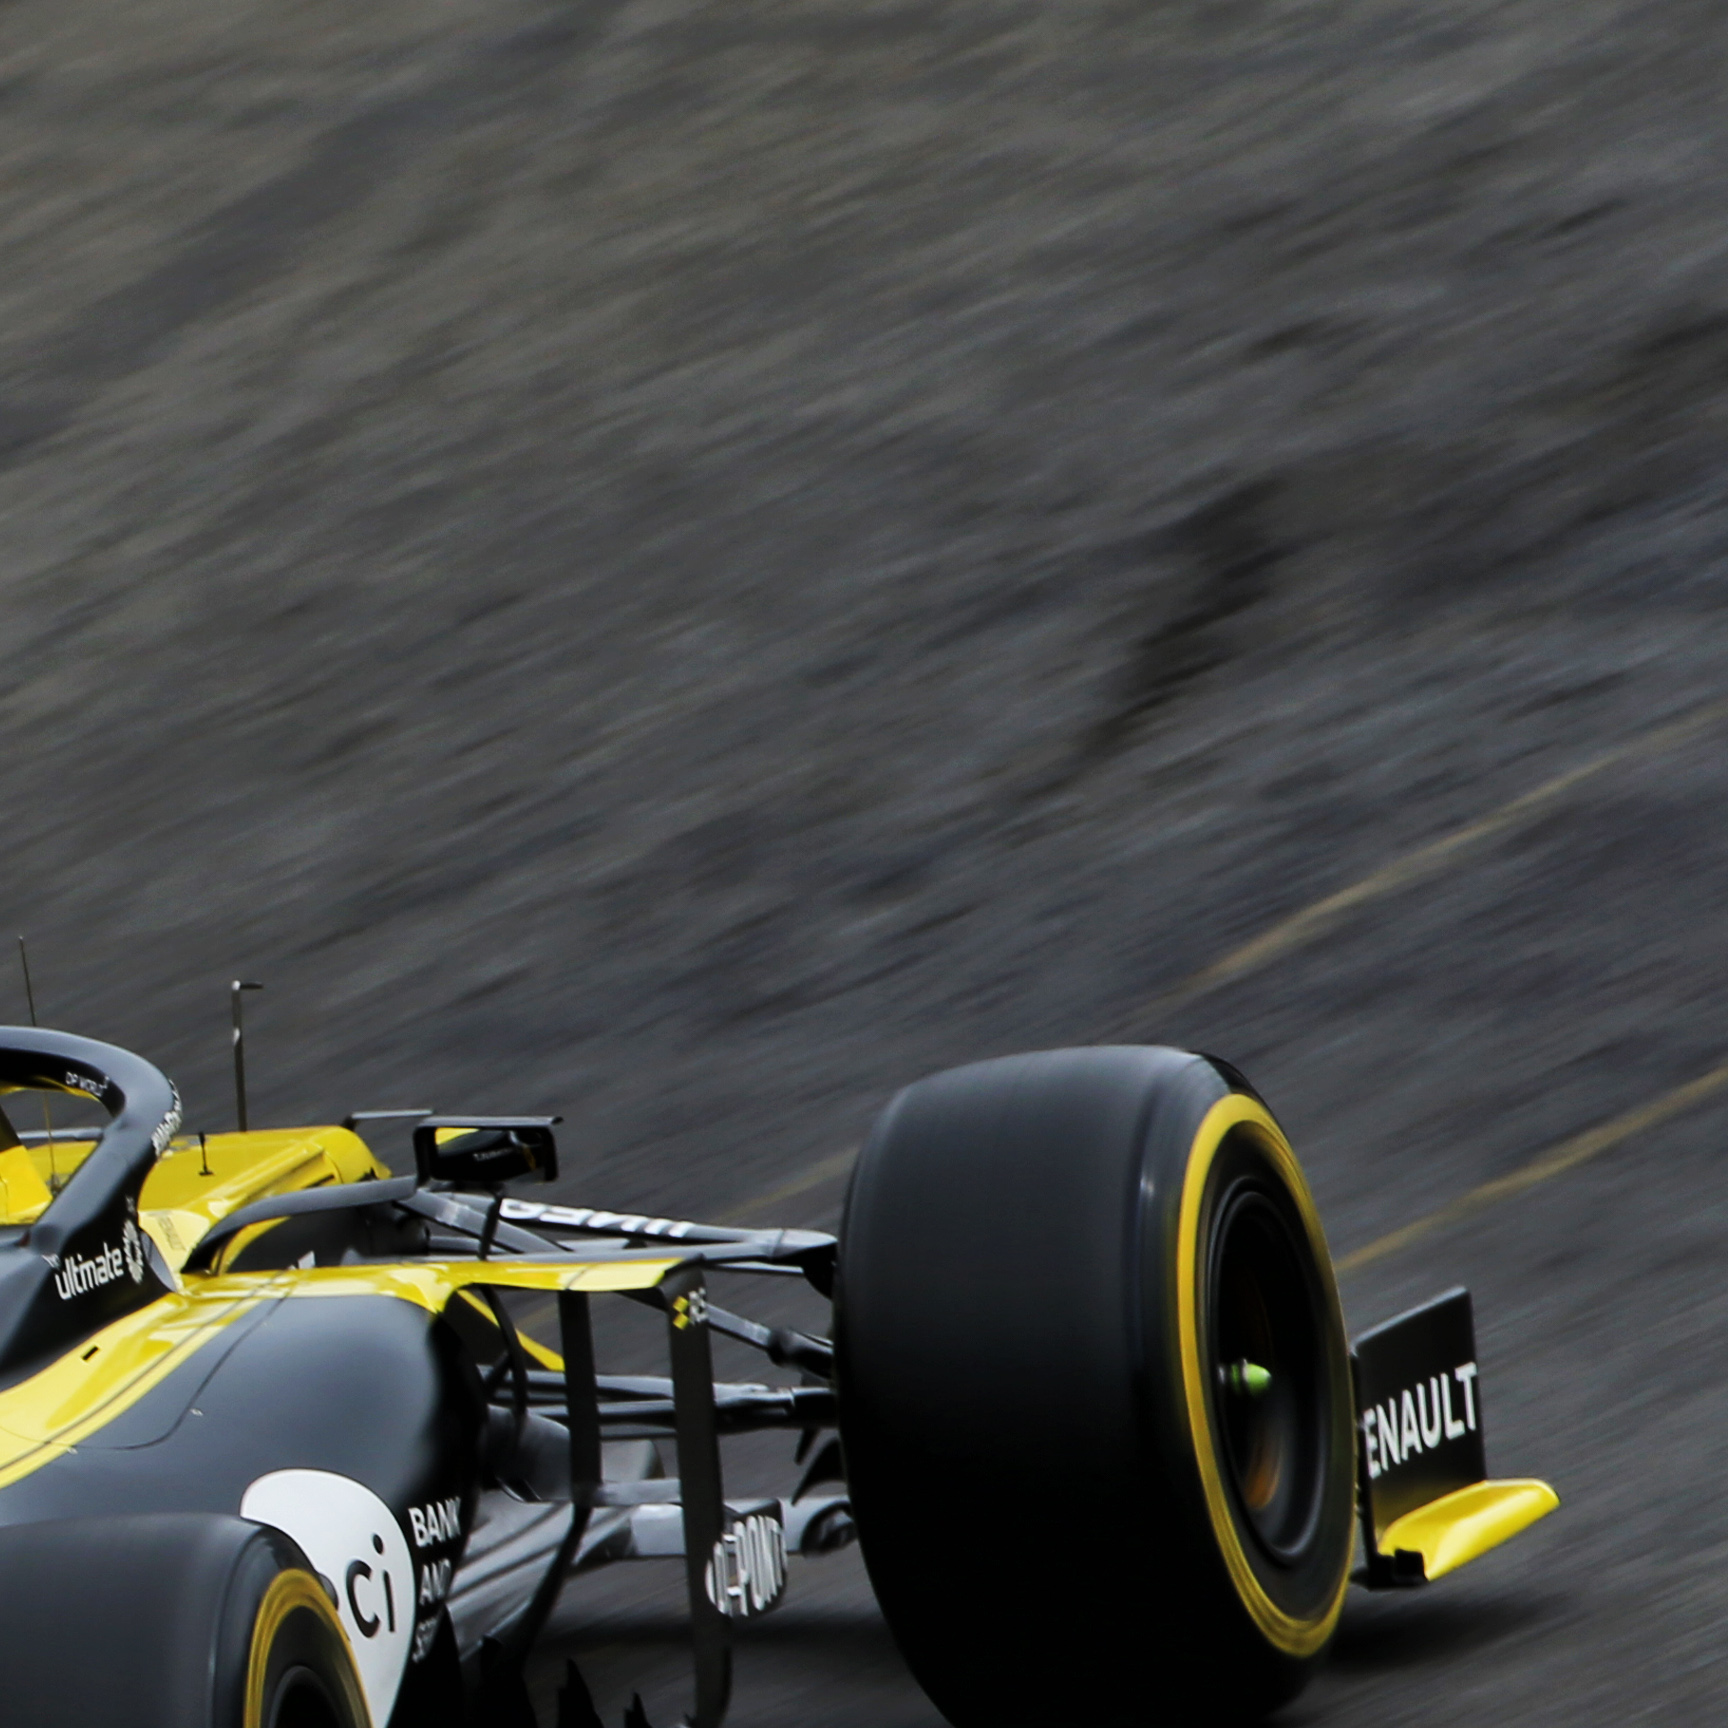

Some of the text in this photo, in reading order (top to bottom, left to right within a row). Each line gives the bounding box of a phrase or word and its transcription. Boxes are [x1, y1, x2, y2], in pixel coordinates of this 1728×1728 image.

[54, 1241, 124, 1301] ultimate
[1360, 1361, 1478, 1479] ENAULT
[408, 1496, 462, 1548] BANK
[319, 1532, 397, 1639] ci
